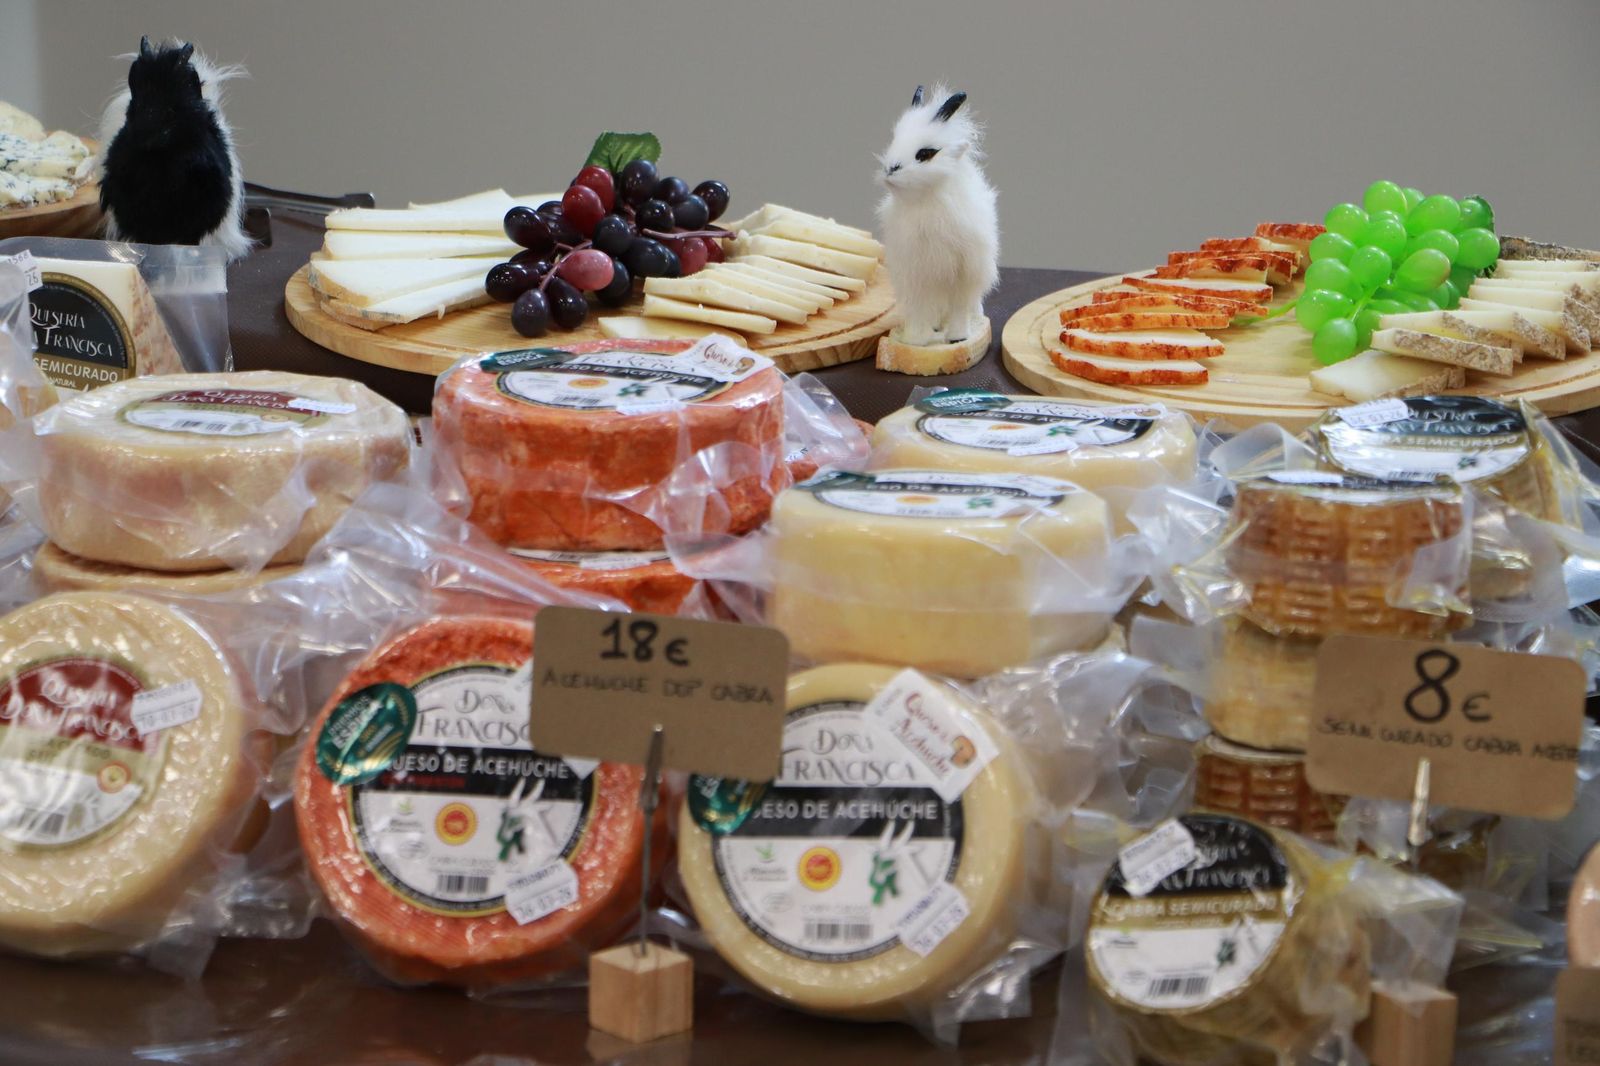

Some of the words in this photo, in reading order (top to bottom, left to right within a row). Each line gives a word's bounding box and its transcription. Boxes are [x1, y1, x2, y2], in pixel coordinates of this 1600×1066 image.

[34, 358, 119, 384] SEMICURADO
[389, 752, 440, 773] UESO
[443, 752, 469, 775] DE
[752, 799, 799, 820] ESO
[802, 799, 830, 820] DE
[834, 798, 939, 821] ACEHÚCHE
